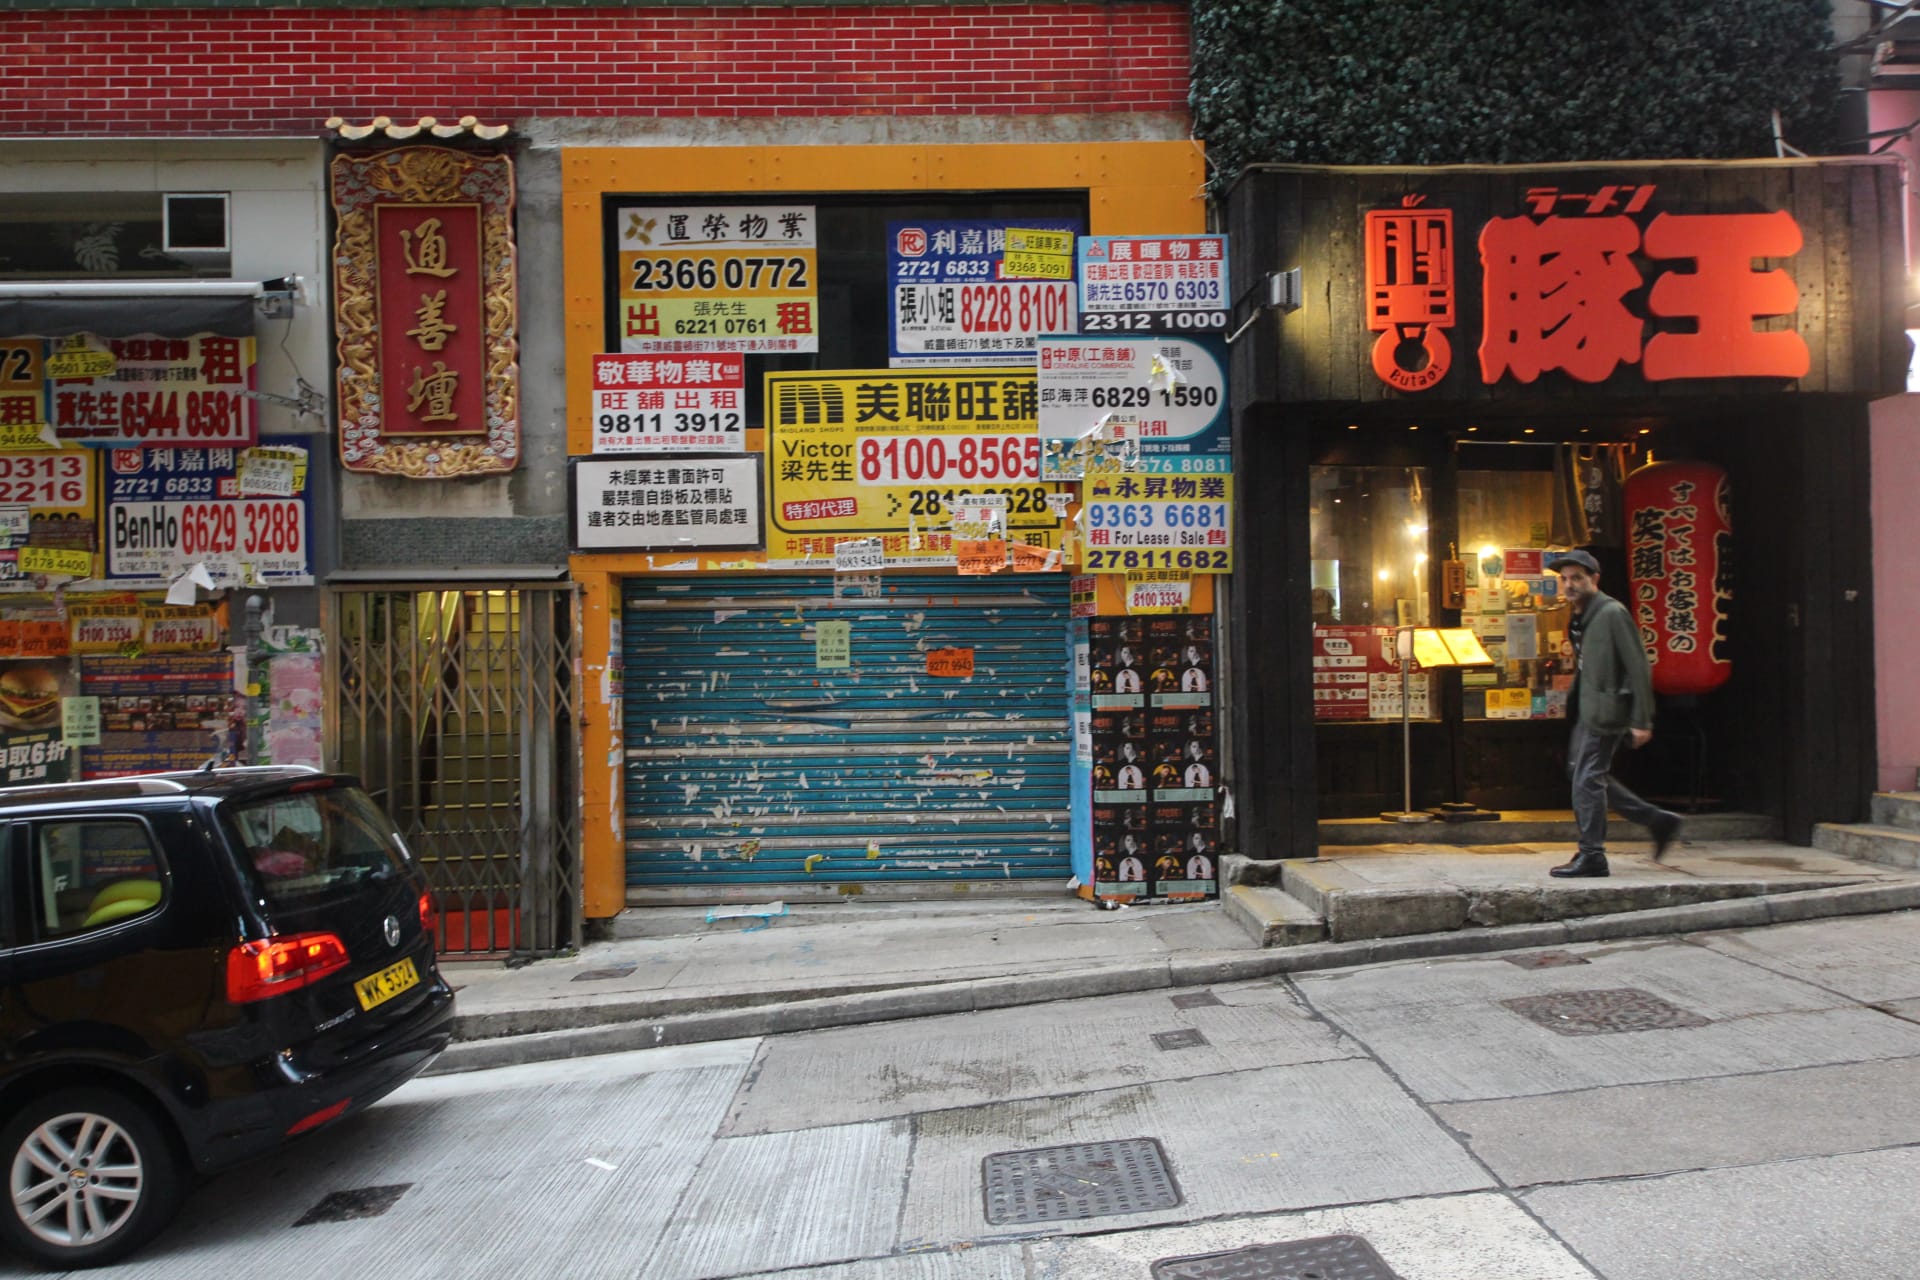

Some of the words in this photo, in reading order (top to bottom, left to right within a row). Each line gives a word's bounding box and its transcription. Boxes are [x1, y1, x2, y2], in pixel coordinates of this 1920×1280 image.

[1525, 184, 1657, 215] ラーメン
[666, 212, 808, 241] 置榮物業
[632, 258, 718, 291] 2366
[723, 257, 808, 289] 0772
[896, 260, 940, 277] 2721
[945, 259, 990, 277] 6833
[1008, 260, 1037, 274] 9368
[1039, 262, 1066, 275] 5091
[1124, 281, 1169, 301] 6570
[1174, 280, 1220, 300] 6303
[1477, 208, 1811, 384] 豚王
[693, 301, 748, 317] 張先生
[900, 286, 955, 325] 張小姐
[960, 284, 1013, 334] 8228
[1018, 283, 1069, 332] 8101
[400, 217, 459, 422] 通善壇
[625, 303, 661, 338] 出
[674, 318, 718, 335] 6221
[724, 317, 767, 334] 0761
[775, 301, 813, 336] 租
[1083, 312, 1152, 330] 2312
[1160, 311, 1227, 329] 1000
[200, 337, 243, 385] 租
[596, 359, 713, 386] 敬華物業
[1388, 362, 1443, 390] Butao!
[55, 391, 119, 426] 黃先生
[1092, 386, 1151, 409] 6829
[1160, 385, 1218, 408] 1590
[120, 391, 180, 438] 6544
[186, 389, 243, 438] 8581
[598, 413, 663, 434] 9811
[674, 412, 740, 433] 3912
[781, 438, 854, 459] Victor
[860, 436, 1039, 481] 8100-8565
[148, 448, 235, 473] 利嘉閣
[780, 459, 855, 482] 梁先生
[1138, 459, 1173, 474] 576
[1181, 458, 1227, 473] 8081
[112, 477, 160, 494] 2721
[165, 476, 213, 494] 6833
[608, 467, 725, 487] 未經業主書面許可
[1114, 476, 1226, 499] 永昇物業
[601, 487, 733, 507] 嚴禁擅自掛板及標貼
[587, 507, 748, 528] 違者交由地產監管局處理
[786, 500, 855, 520] 特約代理
[1089, 504, 1154, 528] 9363
[1164, 503, 1226, 528] 6681
[181, 503, 237, 556] 6629
[243, 502, 300, 554] 3288
[1089, 529, 1111, 546] 租
[1114, 530, 1134, 545] For
[1136, 530, 1170, 546] Lease
[1180, 529, 1205, 545] Sale
[1206, 528, 1227, 546] 售
[1087, 550, 1229, 569] 27811682
[1667, 481, 1697, 653] すべてはお客様の
[1132, 591, 1158, 607] 8100
[1159, 591, 1183, 606] 3334
[361, 980, 384, 1004] WK
